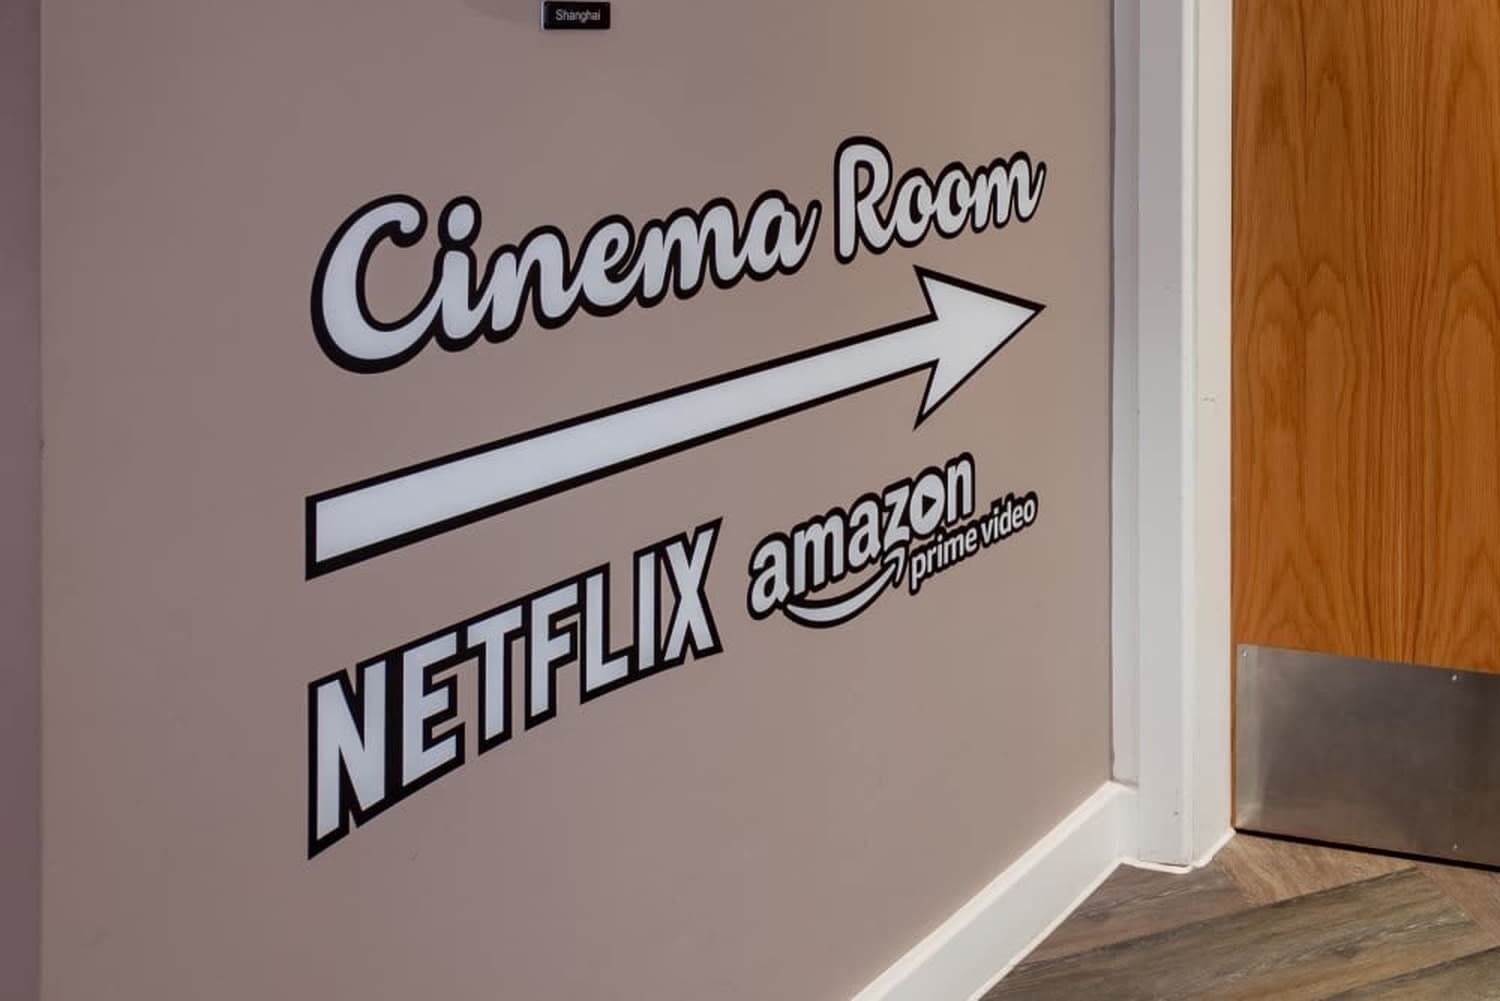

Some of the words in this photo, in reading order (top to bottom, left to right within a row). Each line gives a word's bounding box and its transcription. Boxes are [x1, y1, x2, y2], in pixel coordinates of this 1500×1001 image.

[310, 189, 823, 375] Cinema
[833, 135, 1047, 265] Room
[747, 451, 976, 620] amazon
[908, 524, 978, 596] prime
[979, 490, 1040, 547] video
[307, 516, 724, 860] NETFLIX
